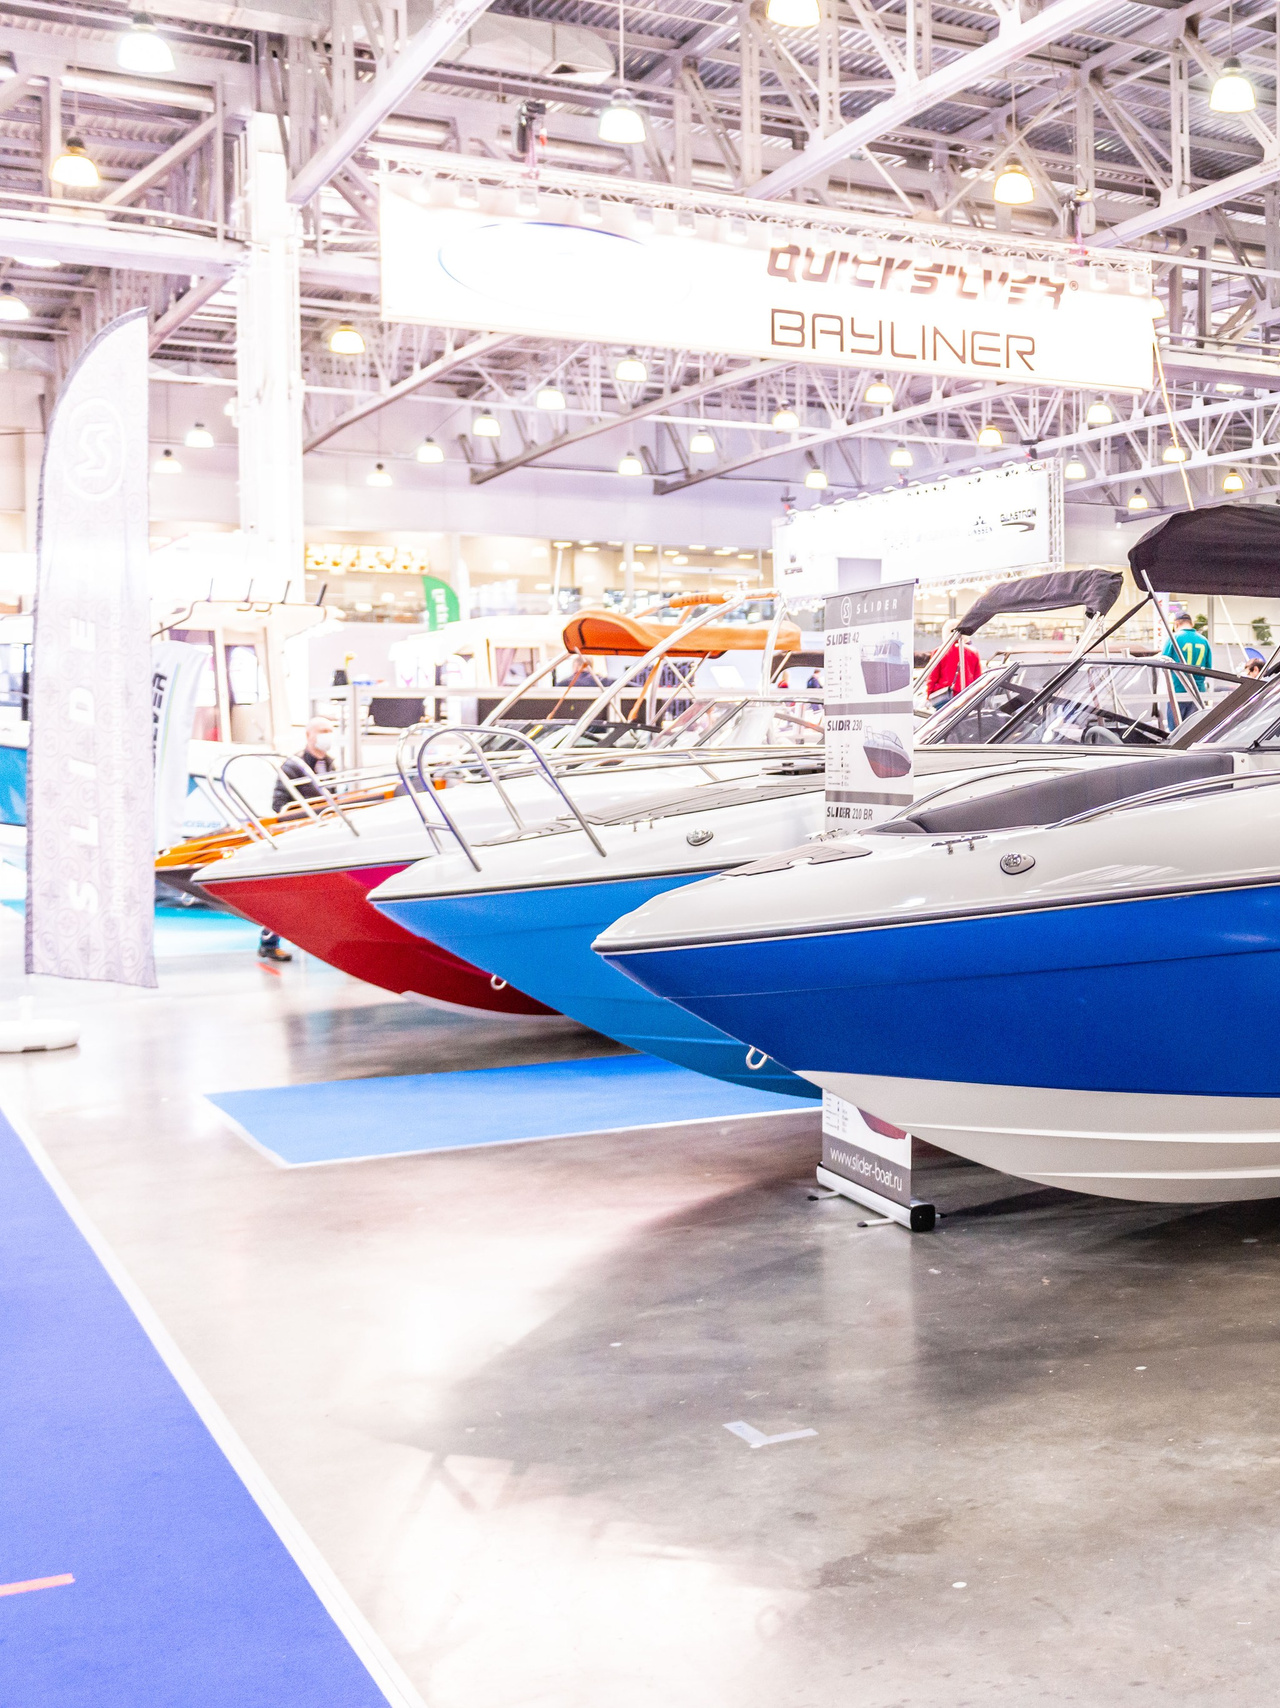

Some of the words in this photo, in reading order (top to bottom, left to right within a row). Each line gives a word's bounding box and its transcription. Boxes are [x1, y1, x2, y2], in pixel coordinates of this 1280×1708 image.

[770, 308, 1035, 371] BAYLINER
[856, 598, 898, 615] SLIDER
[826, 632, 852, 647] SLIDER
[851, 719, 863, 731] 230
[826, 806, 851, 819] SLIDER
[863, 808, 874, 821] BR
[829, 1147, 903, 1191] www.slider-boat.ru
